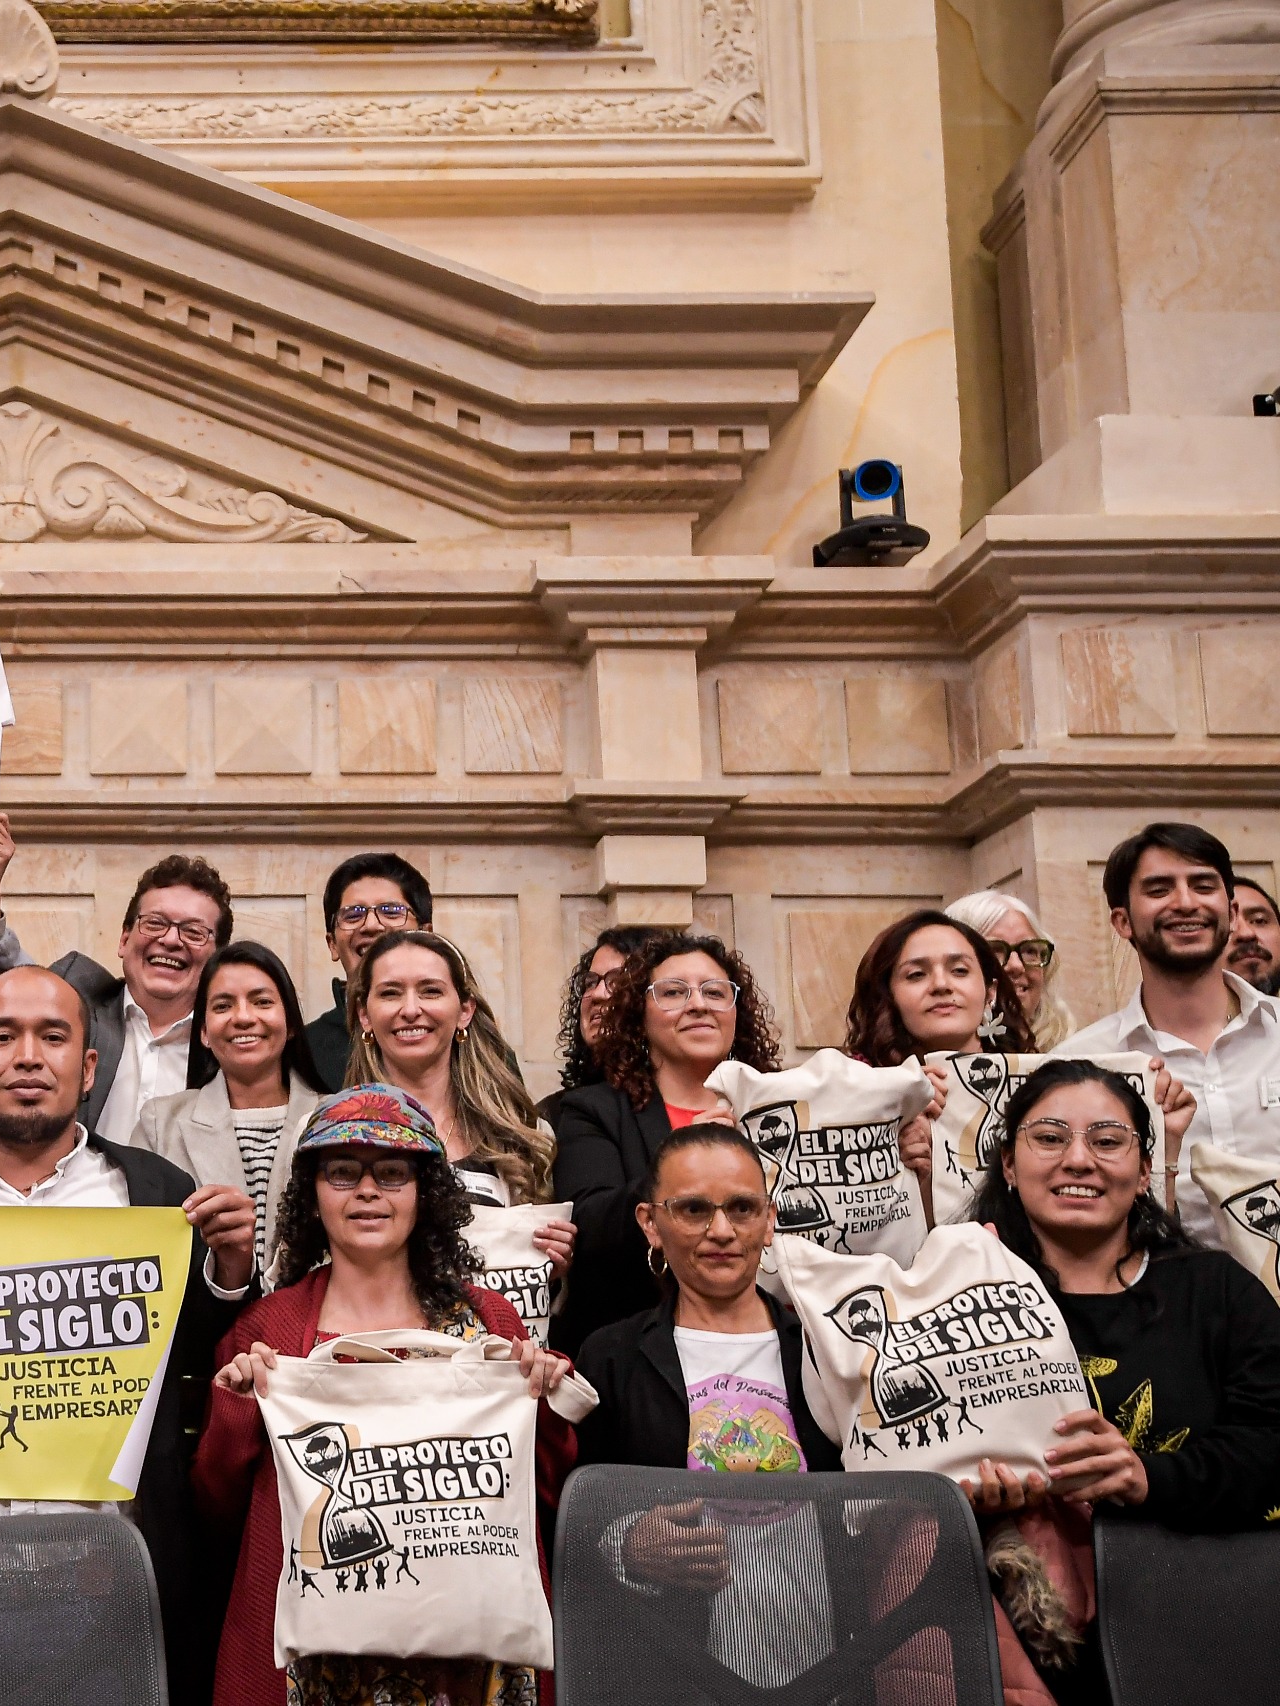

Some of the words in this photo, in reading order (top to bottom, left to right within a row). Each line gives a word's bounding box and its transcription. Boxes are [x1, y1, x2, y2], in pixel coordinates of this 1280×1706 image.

[800, 1132, 823, 1154] EL
[799, 1160, 843, 1184] DEL
[835, 1185, 899, 1205] JUSTICIA
[845, 1204, 887, 1219] FRENTE
[891, 1321, 920, 1342] EL
[918, 1281, 1042, 1331] PROYECTO
[17, 1300, 161, 1352] SIGLO:
[896, 1333, 951, 1364] DEL
[947, 1307, 1056, 1352] SIGLO:
[945, 1346, 1042, 1377] JUSTICIA
[713, 1379, 730, 1391] del
[958, 1368, 1017, 1391] FRENTE
[1022, 1365, 1038, 1378] AL
[1040, 1361, 1078, 1376] PODER
[12, 1383, 83, 1400] FRENTE
[90, 1382, 109, 1395] AL
[113, 1377, 151, 1395] POD
[970, 1378, 1085, 1409] EMPRESARIAL
[355, 1450, 380, 1474] EL
[381, 1435, 510, 1469] PROYECTO
[352, 1476, 402, 1506] DEL
[402, 1464, 510, 1501] SIGLO:
[391, 1506, 486, 1526] JUSTICIA
[404, 1525, 461, 1541] FRENTE
[467, 1525, 482, 1537] AL
[483, 1525, 519, 1540] PODER
[413, 1540, 520, 1559] EMPRESARIAL
